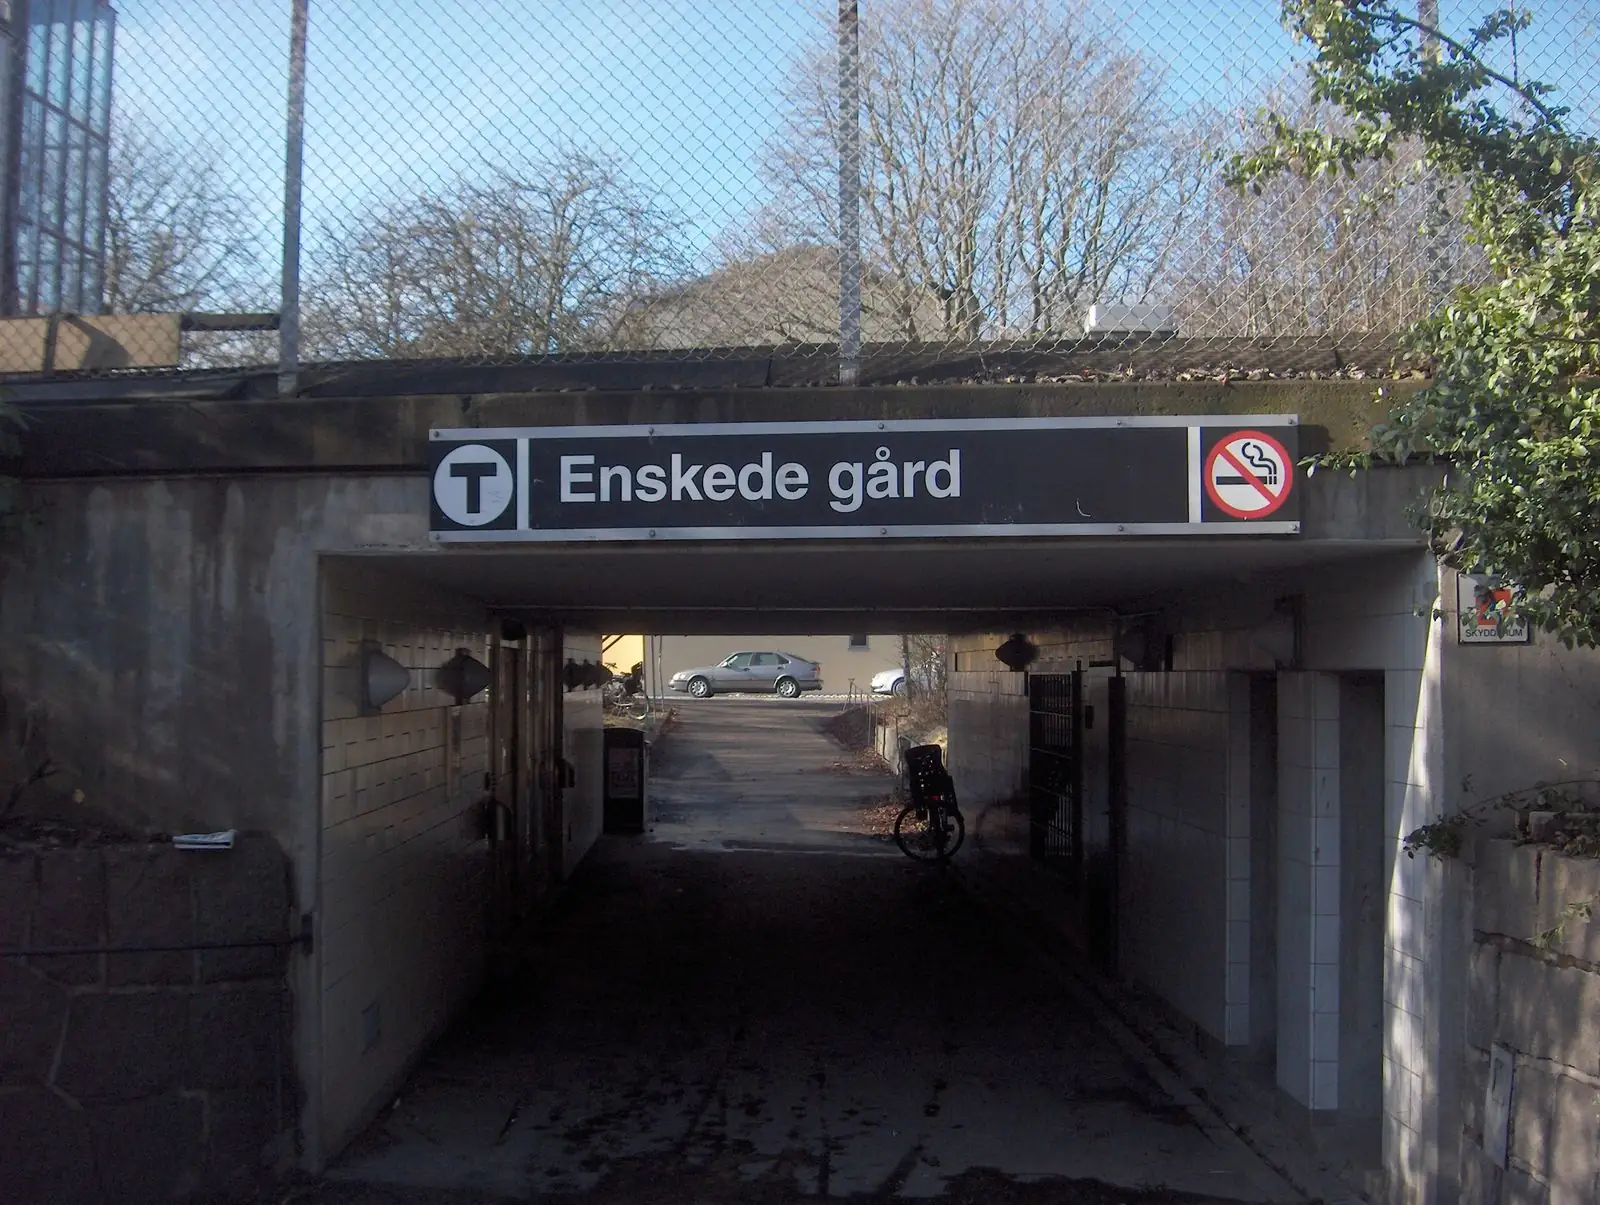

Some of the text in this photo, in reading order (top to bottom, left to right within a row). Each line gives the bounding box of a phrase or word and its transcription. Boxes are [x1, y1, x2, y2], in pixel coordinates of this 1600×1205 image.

[449, 446, 961, 514] T Enskede gård
